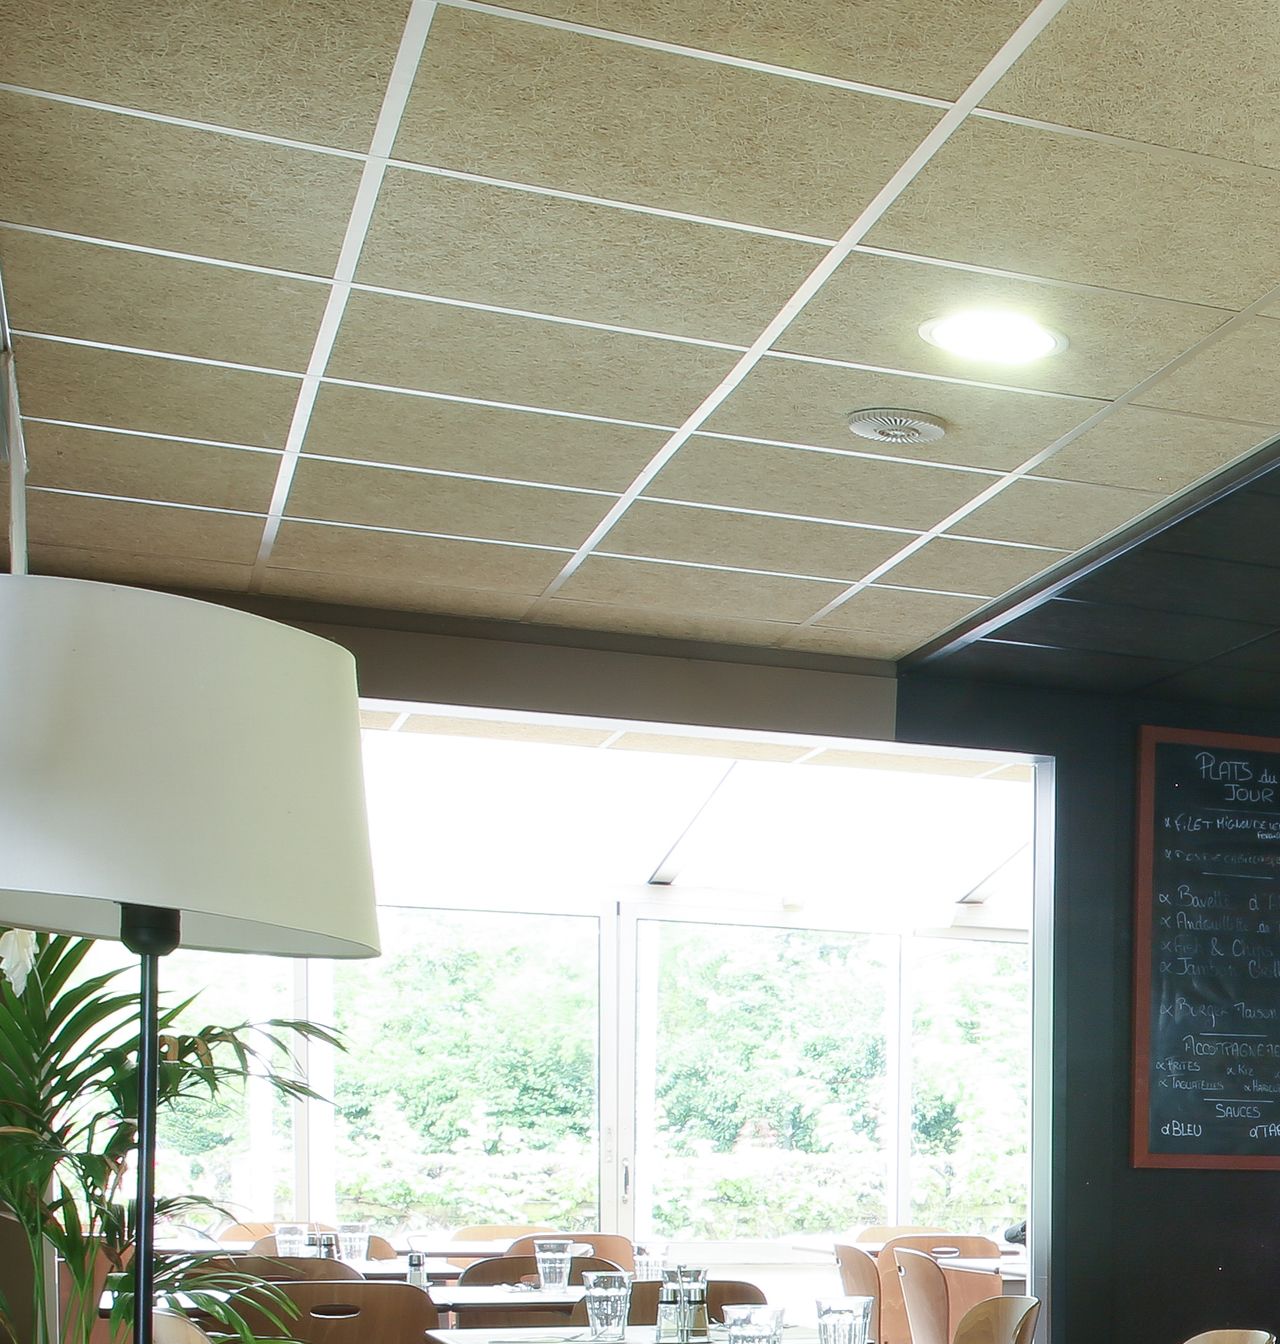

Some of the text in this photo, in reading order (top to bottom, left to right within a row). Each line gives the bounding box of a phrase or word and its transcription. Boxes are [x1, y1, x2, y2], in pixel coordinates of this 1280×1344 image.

[1195, 752, 1278, 783] PLATS du
[1223, 783, 1275, 803] JOUR
[1216, 1103, 1261, 1119] SAUCES
[1171, 1120, 1202, 1137] BLEU
